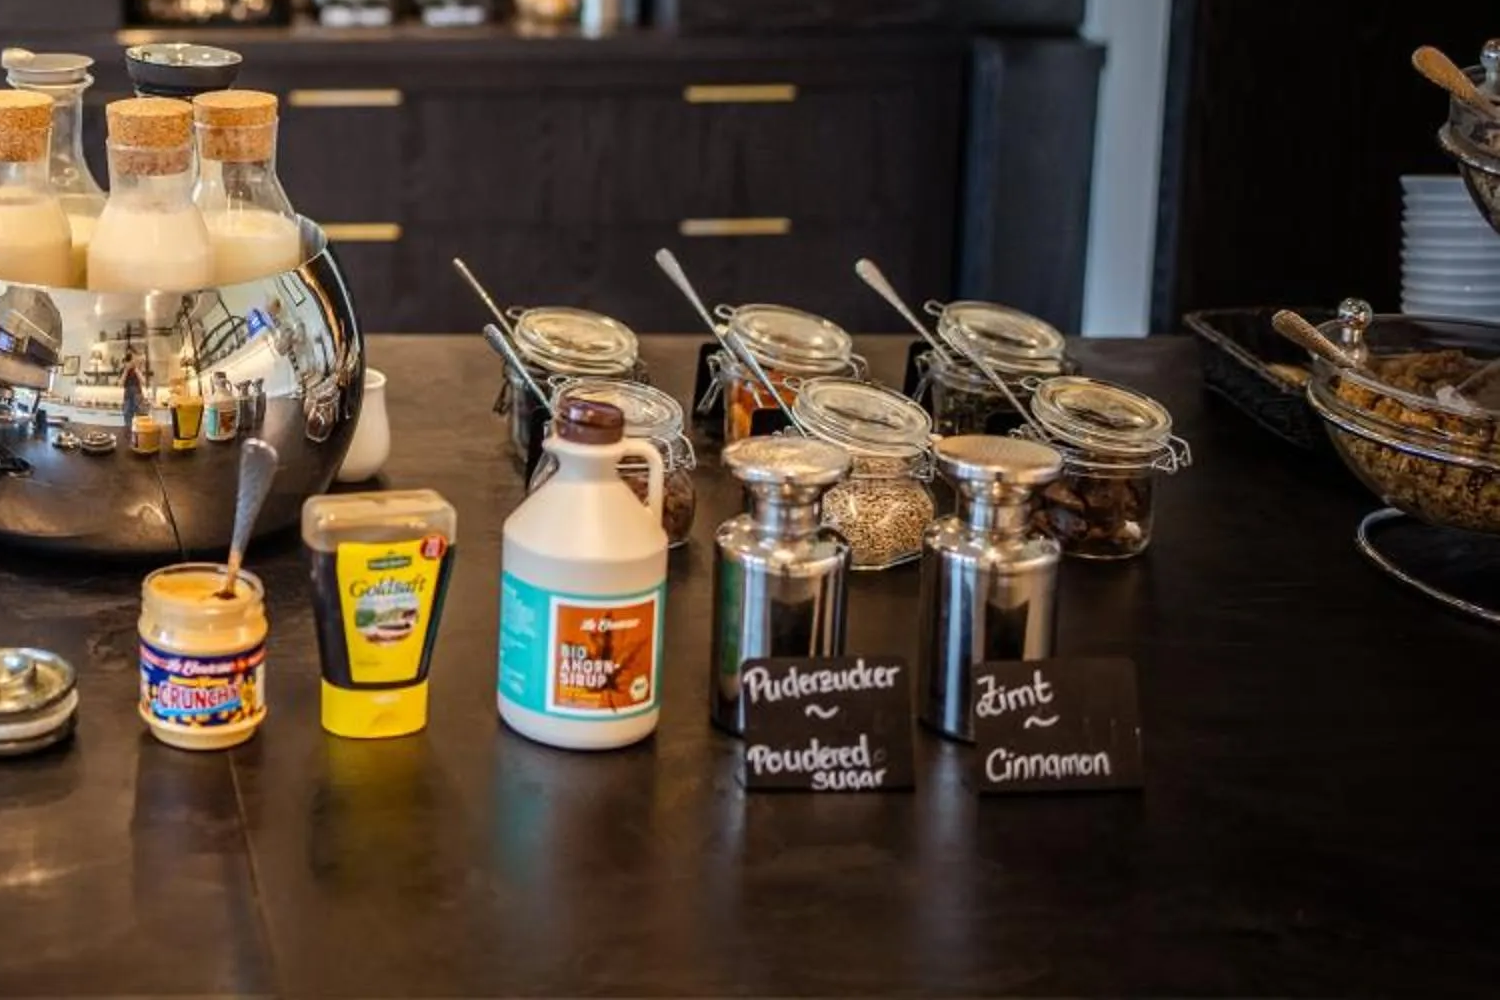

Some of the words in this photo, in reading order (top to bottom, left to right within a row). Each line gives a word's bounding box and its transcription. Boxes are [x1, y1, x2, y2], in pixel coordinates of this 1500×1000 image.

[743, 659, 900, 703] Puderzucker
[976, 669, 1054, 718] Zimt
[811, 767, 887, 790] sugar
[985, 747, 1111, 782] Cinnamon
